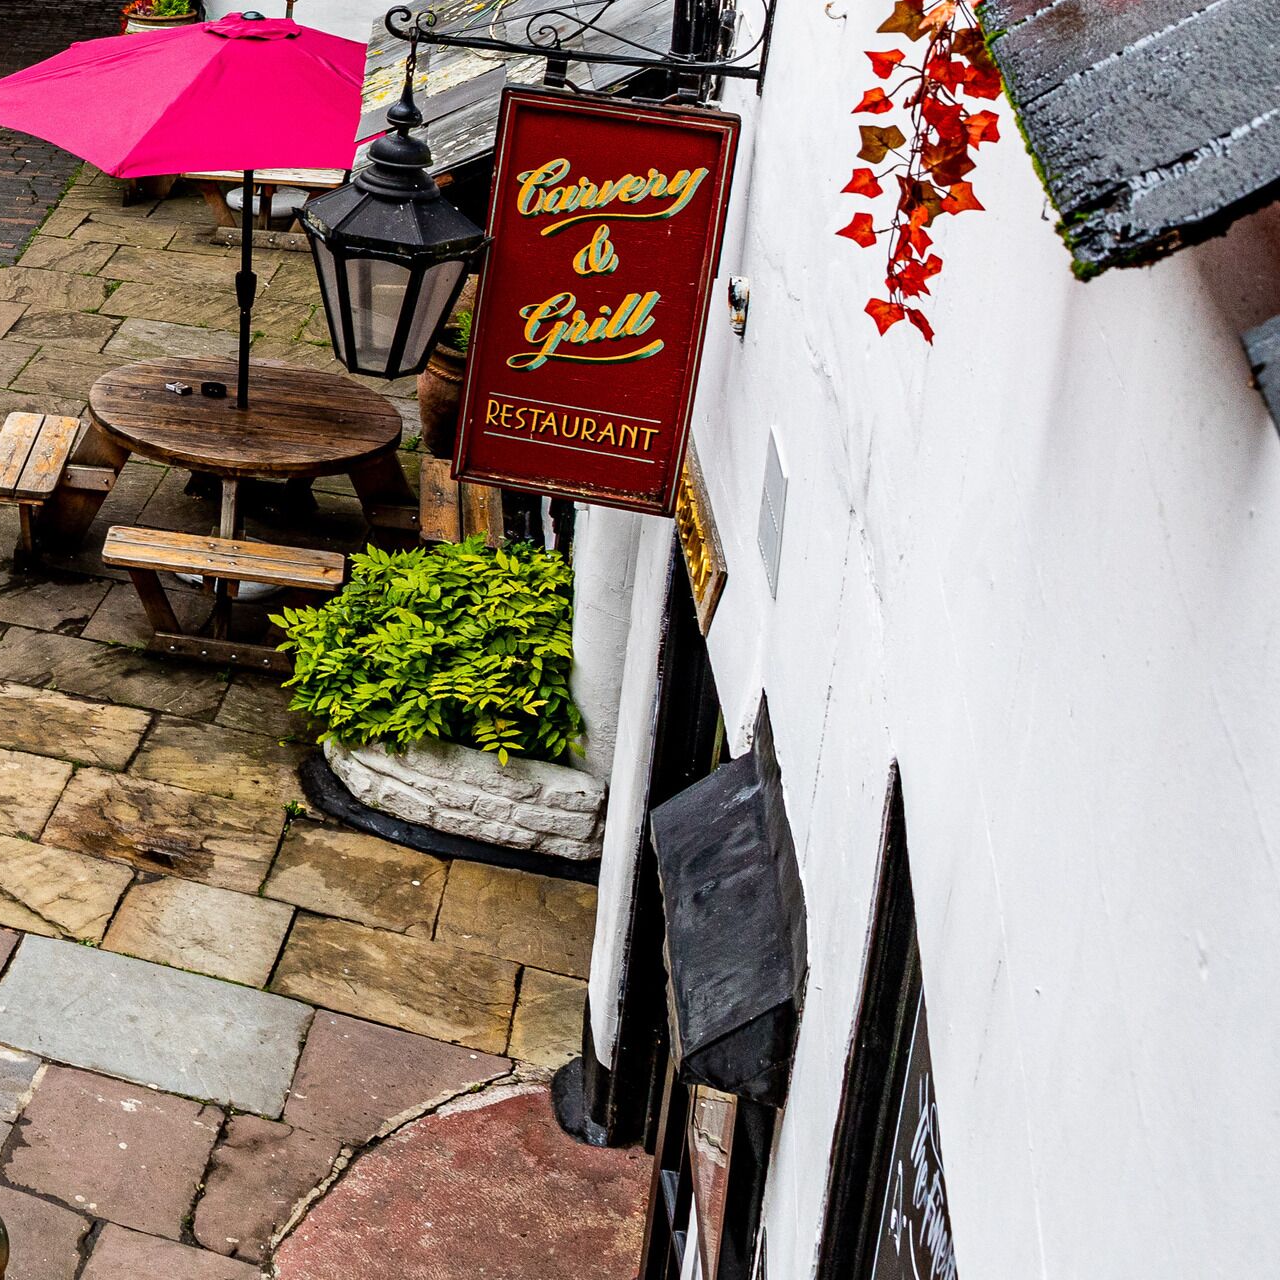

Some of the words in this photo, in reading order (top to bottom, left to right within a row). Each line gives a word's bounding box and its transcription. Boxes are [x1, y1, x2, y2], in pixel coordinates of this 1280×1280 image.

[516, 158, 709, 236] Carvery
[573, 223, 619, 276] &
[506, 291, 664, 371] Grill
[486, 399, 659, 451] RESTAURANT
